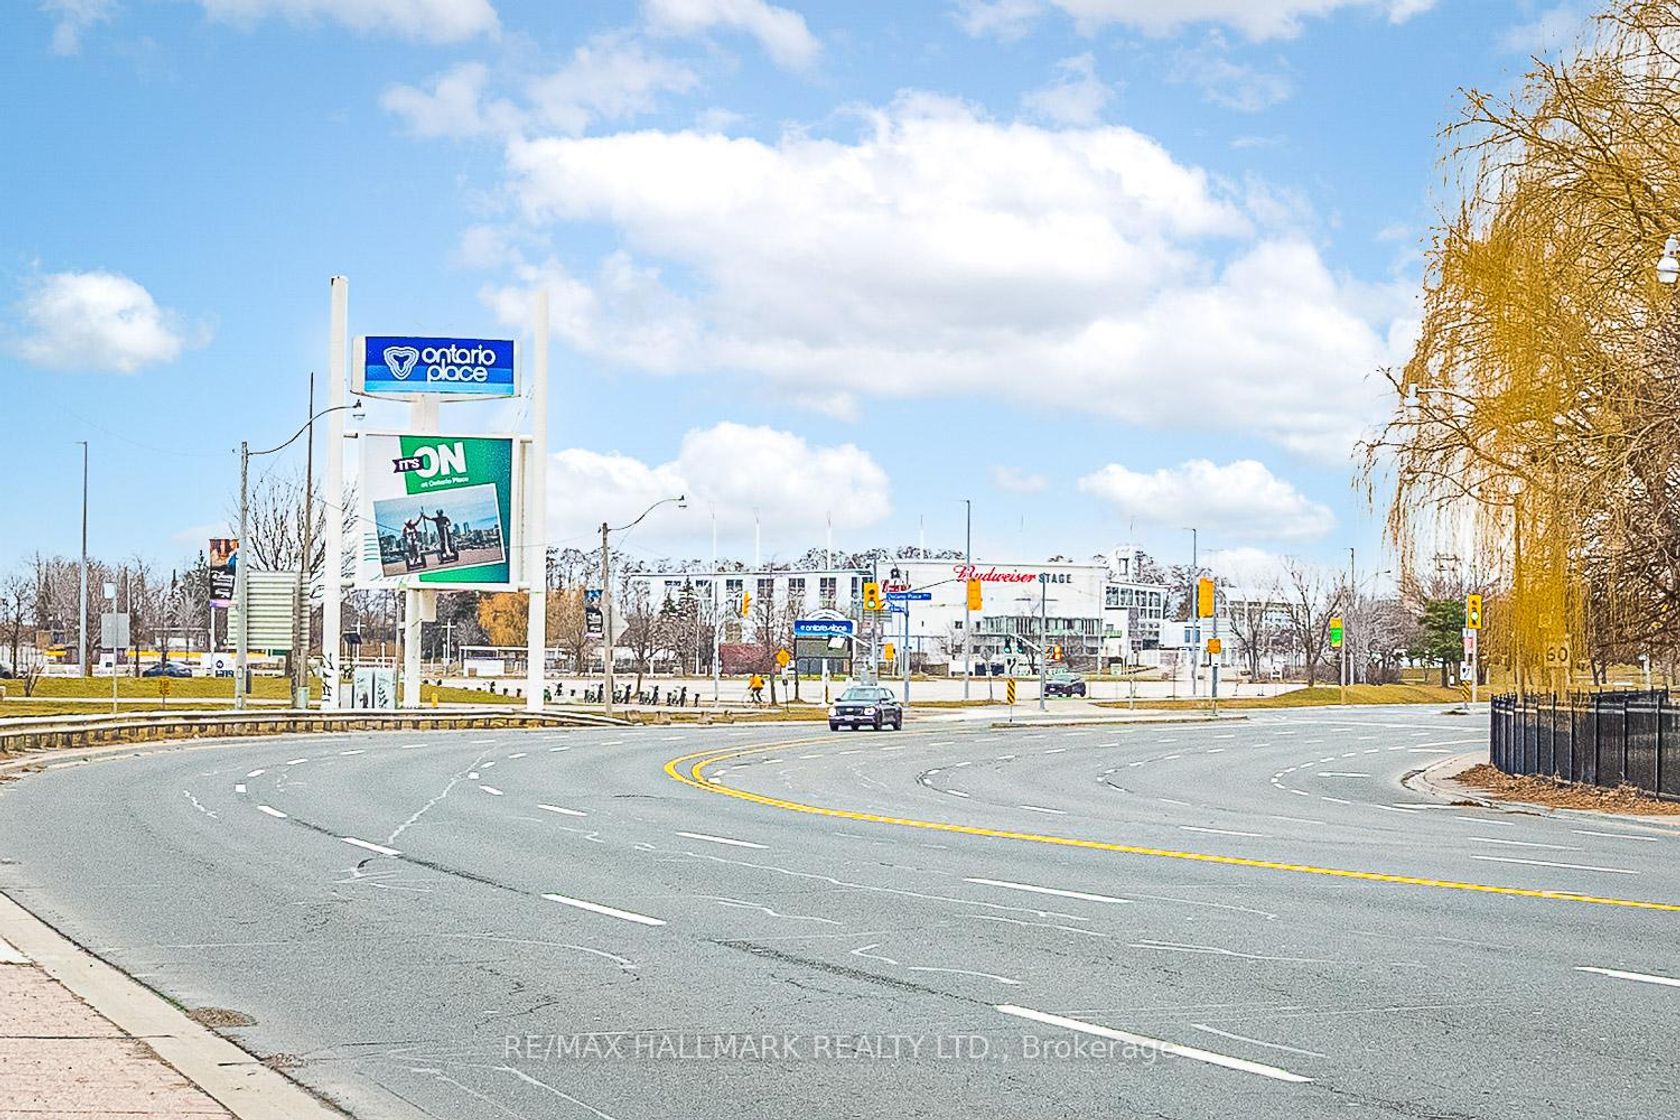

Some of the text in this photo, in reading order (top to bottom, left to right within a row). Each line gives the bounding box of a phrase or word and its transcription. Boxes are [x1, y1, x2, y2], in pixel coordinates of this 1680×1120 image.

[421, 344, 496, 365] ontario
[427, 358, 488, 383] place
[413, 442, 467, 478] ON
[1038, 572, 1073, 584] STAGE
[1546, 646, 1568, 662] 60
